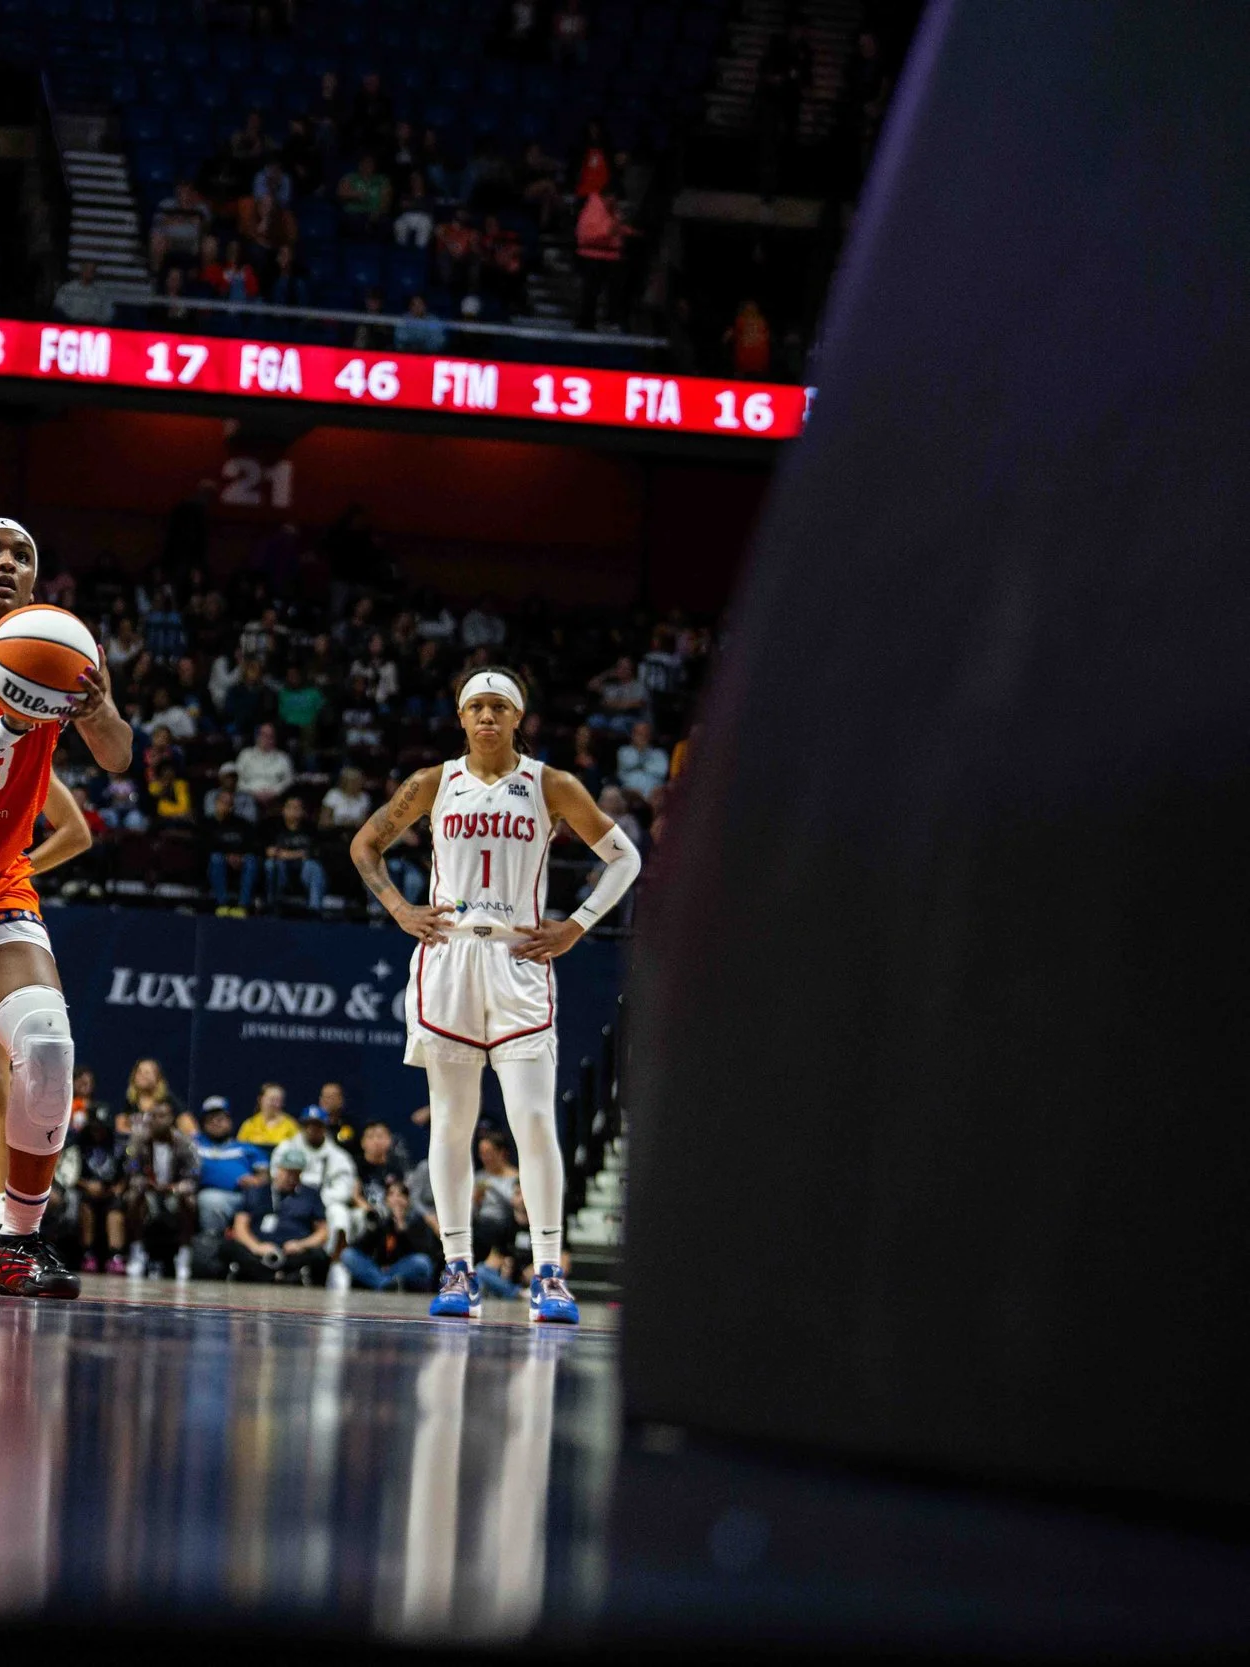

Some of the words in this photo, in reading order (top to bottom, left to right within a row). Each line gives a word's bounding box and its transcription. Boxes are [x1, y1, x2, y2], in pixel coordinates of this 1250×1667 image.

[40, 327, 110, 377] FGM
[146, 343, 208, 383] 17
[239, 344, 302, 393] FGA
[335, 360, 399, 400] 46
[432, 361, 498, 409] FTM
[533, 375, 591, 416] 13
[626, 378, 681, 424] FTA
[715, 391, 774, 431] 16
[221, 457, 293, 507] 21
[480, 849, 491, 889] 1
[468, 902, 515, 914] VANDA
[105, 966, 198, 1010] LUX
[204, 974, 337, 1018] BOND
[344, 982, 385, 1022] &
